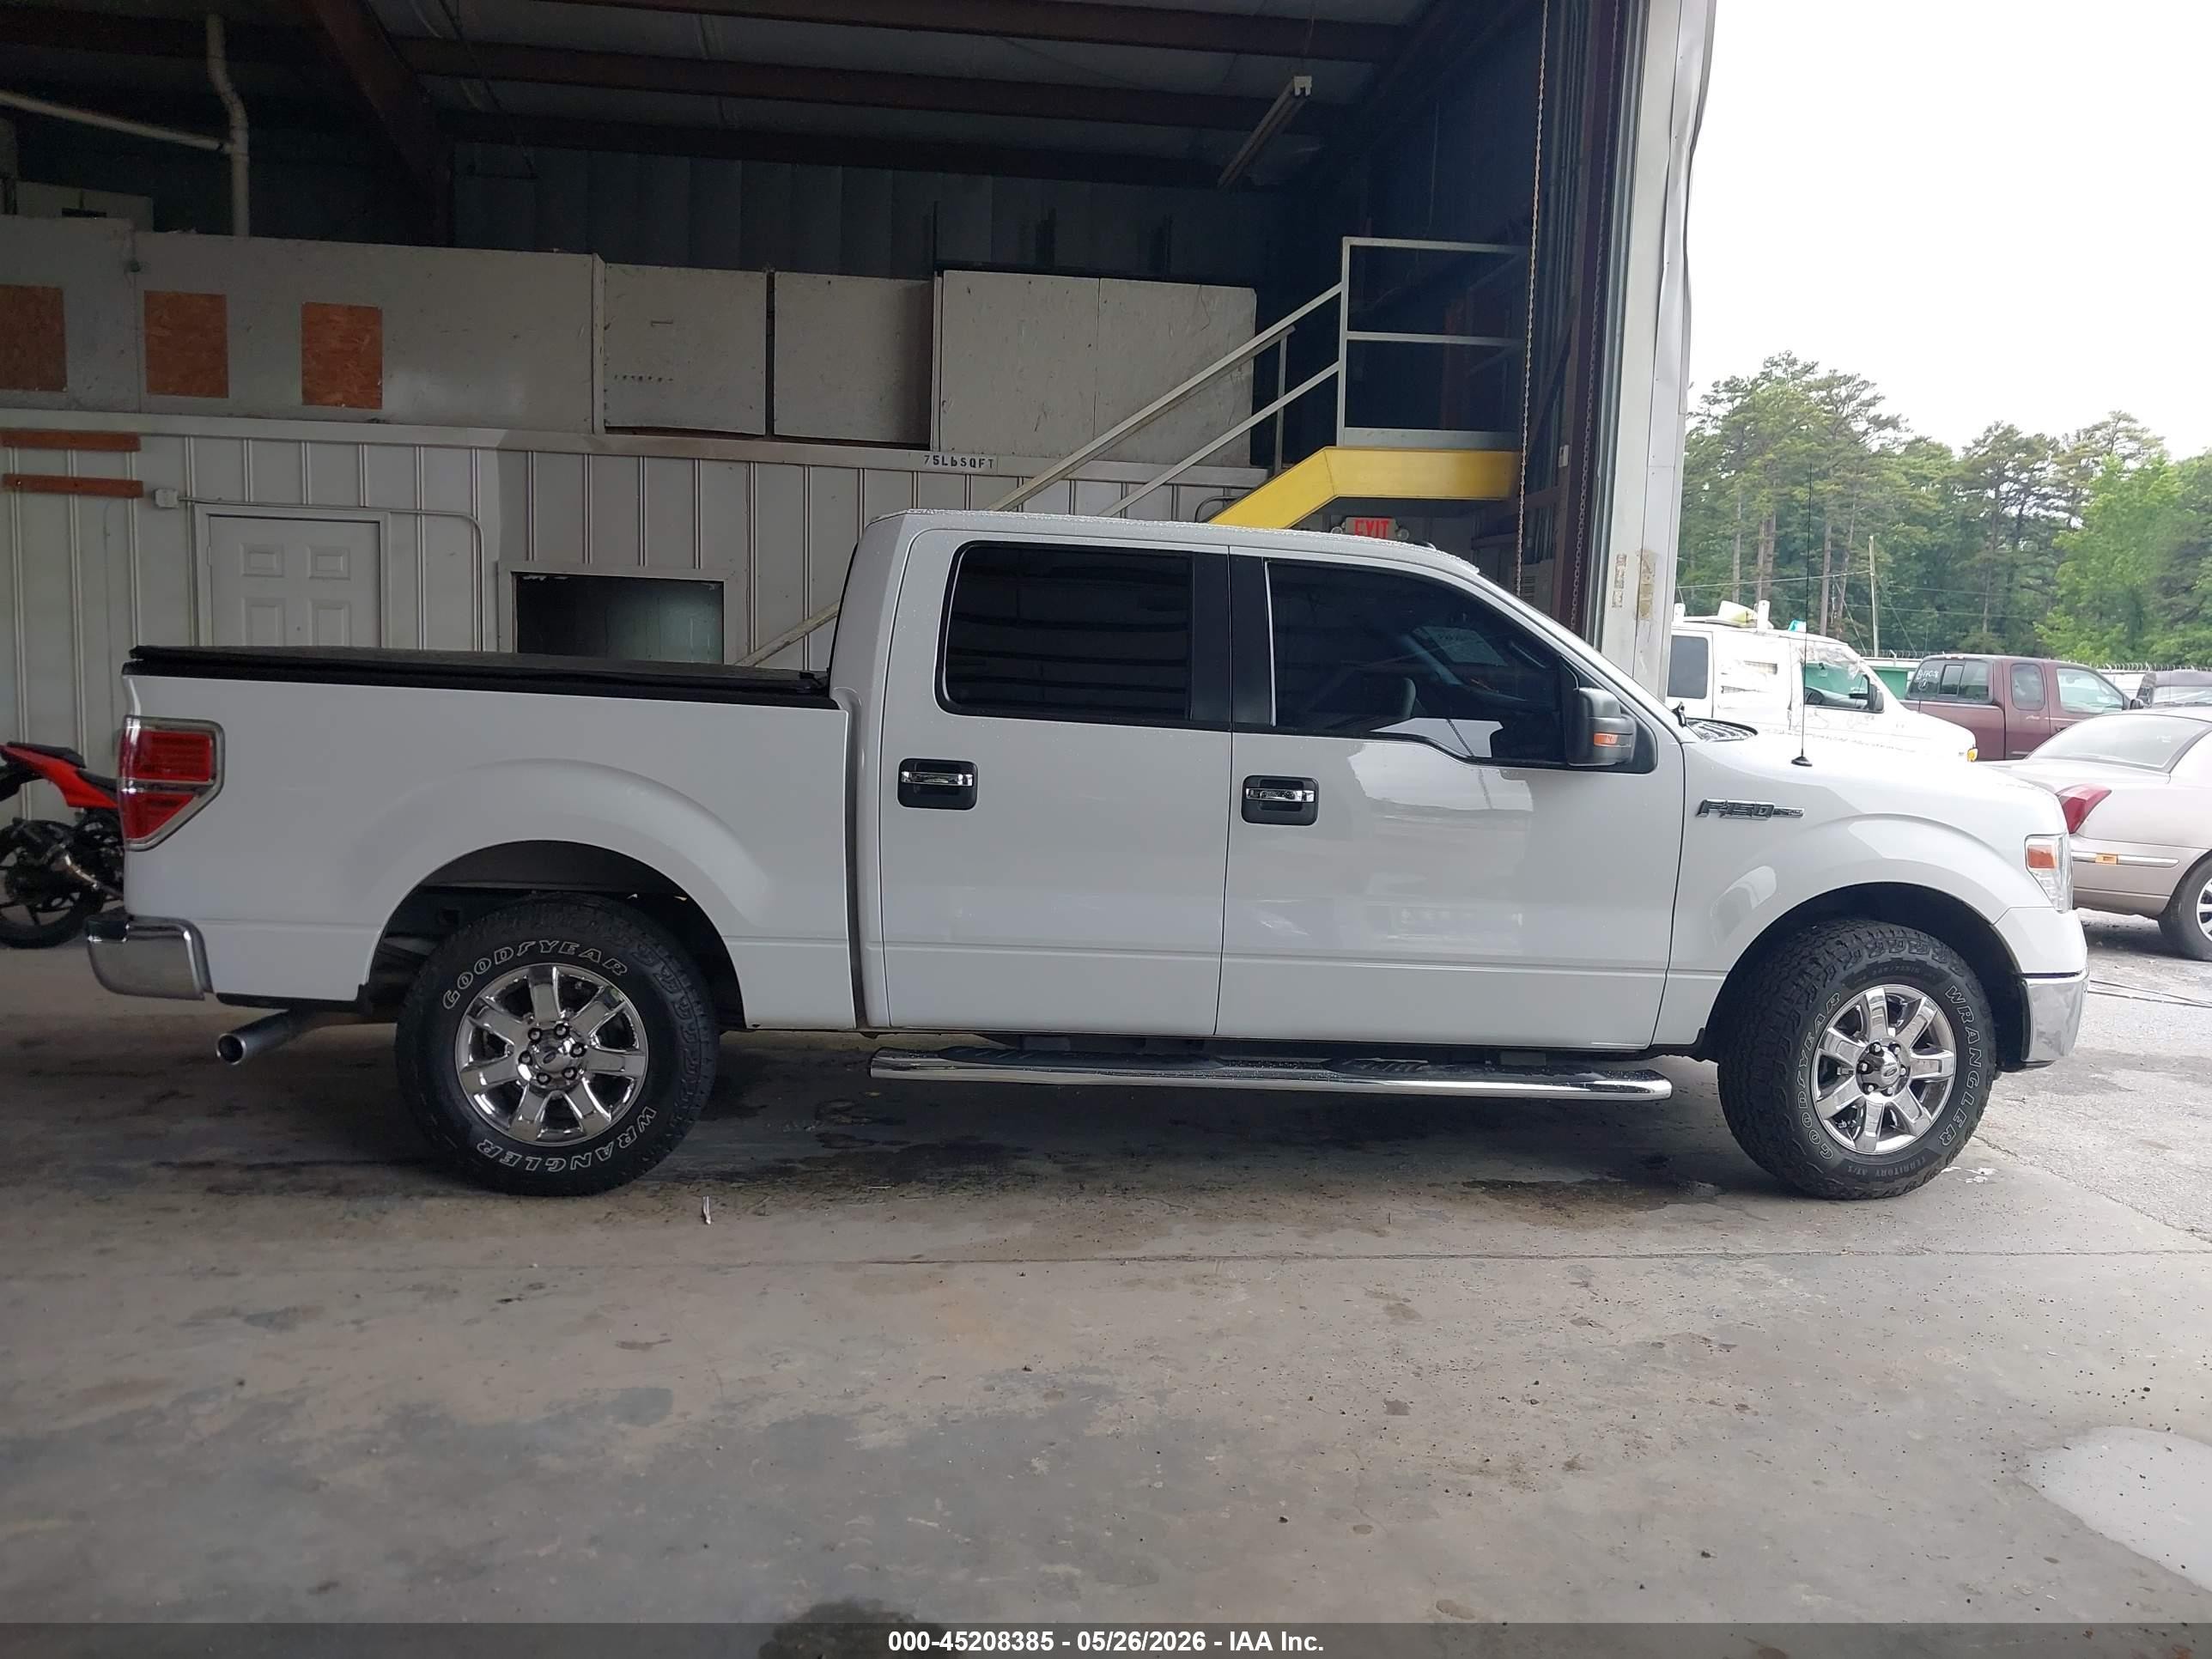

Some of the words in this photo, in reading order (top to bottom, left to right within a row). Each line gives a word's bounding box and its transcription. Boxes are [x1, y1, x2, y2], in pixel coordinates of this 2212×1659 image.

[1354, 519, 1389, 539] EXIT
[443, 940, 629, 1010] GOODYEAR
[1796, 993, 1841, 1160] GOODYEAR
[1939, 985, 1982, 1147] WRANGLER
[476, 1106, 657, 1172] WRANGLER
